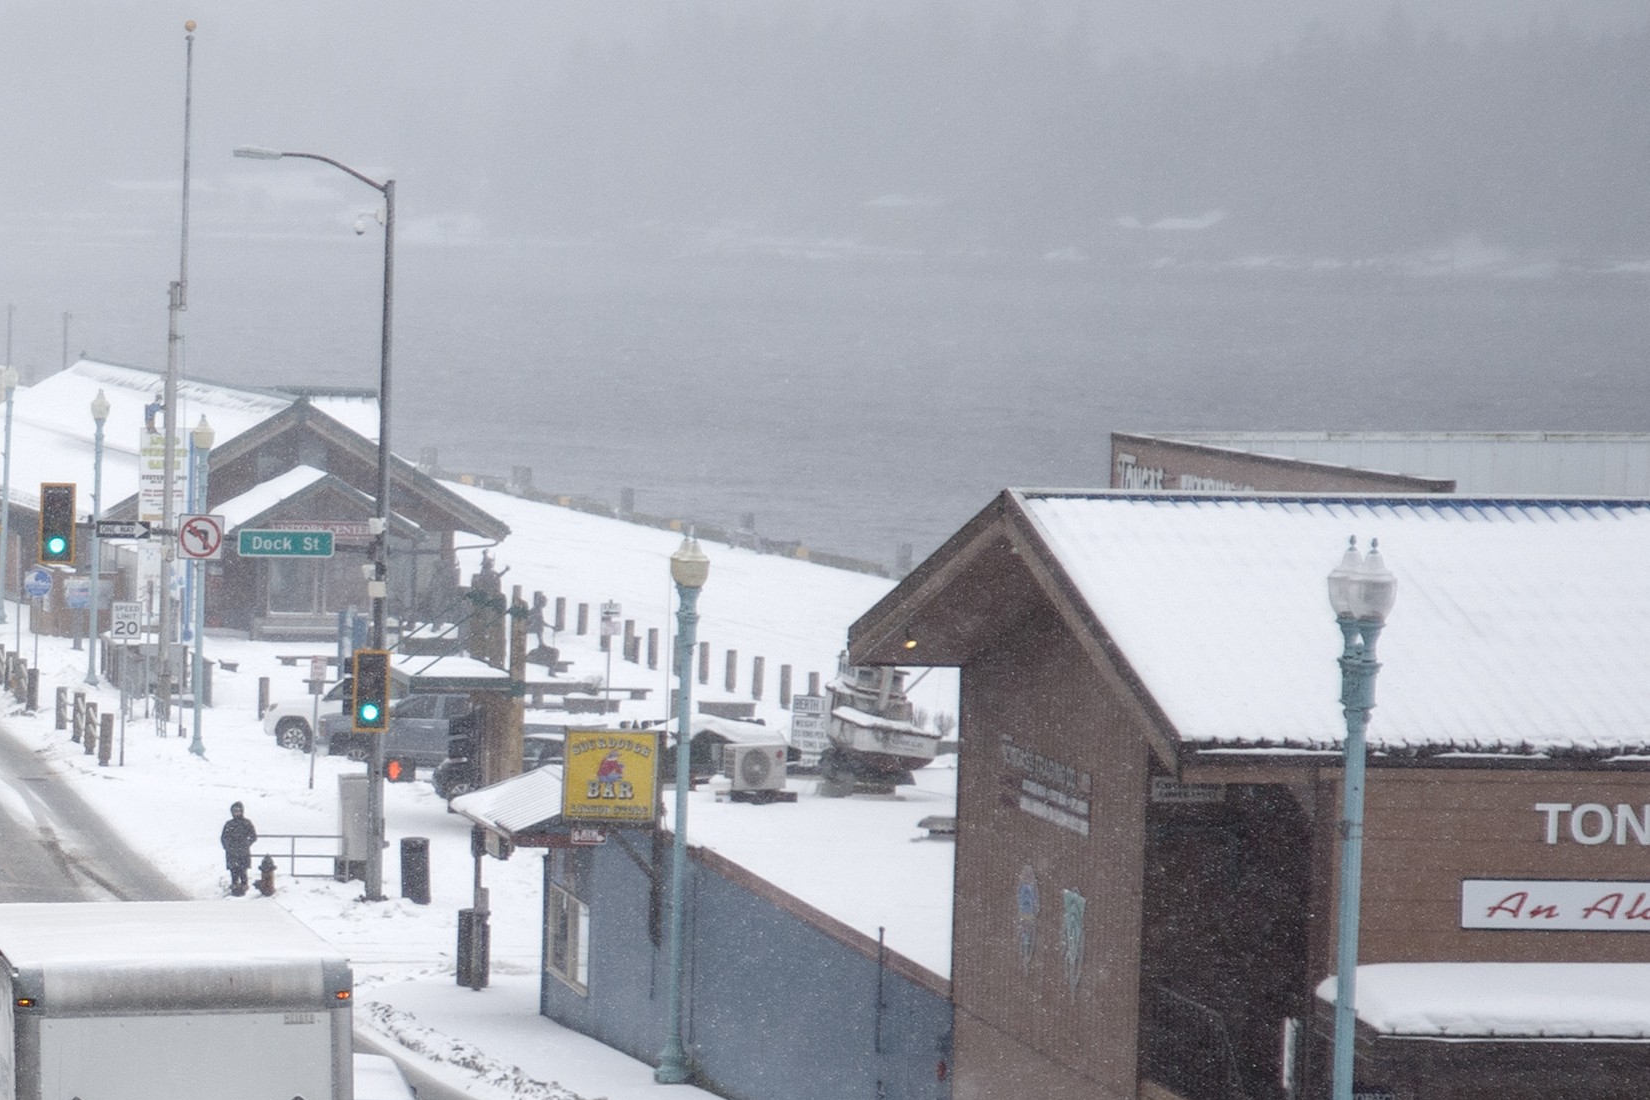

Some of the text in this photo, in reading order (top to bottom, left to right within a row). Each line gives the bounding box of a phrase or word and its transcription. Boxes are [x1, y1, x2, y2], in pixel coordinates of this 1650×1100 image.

[120, 525, 135, 533] WAY
[252, 536, 320, 550] Dock St
[114, 621, 138, 635] 20
[795, 698, 819, 711] BERTH
[571, 737, 653, 758] SOURDOUGH
[586, 779, 635, 799] BAR
[1535, 802, 1650, 846] TON
[1486, 891, 1560, 919] An
